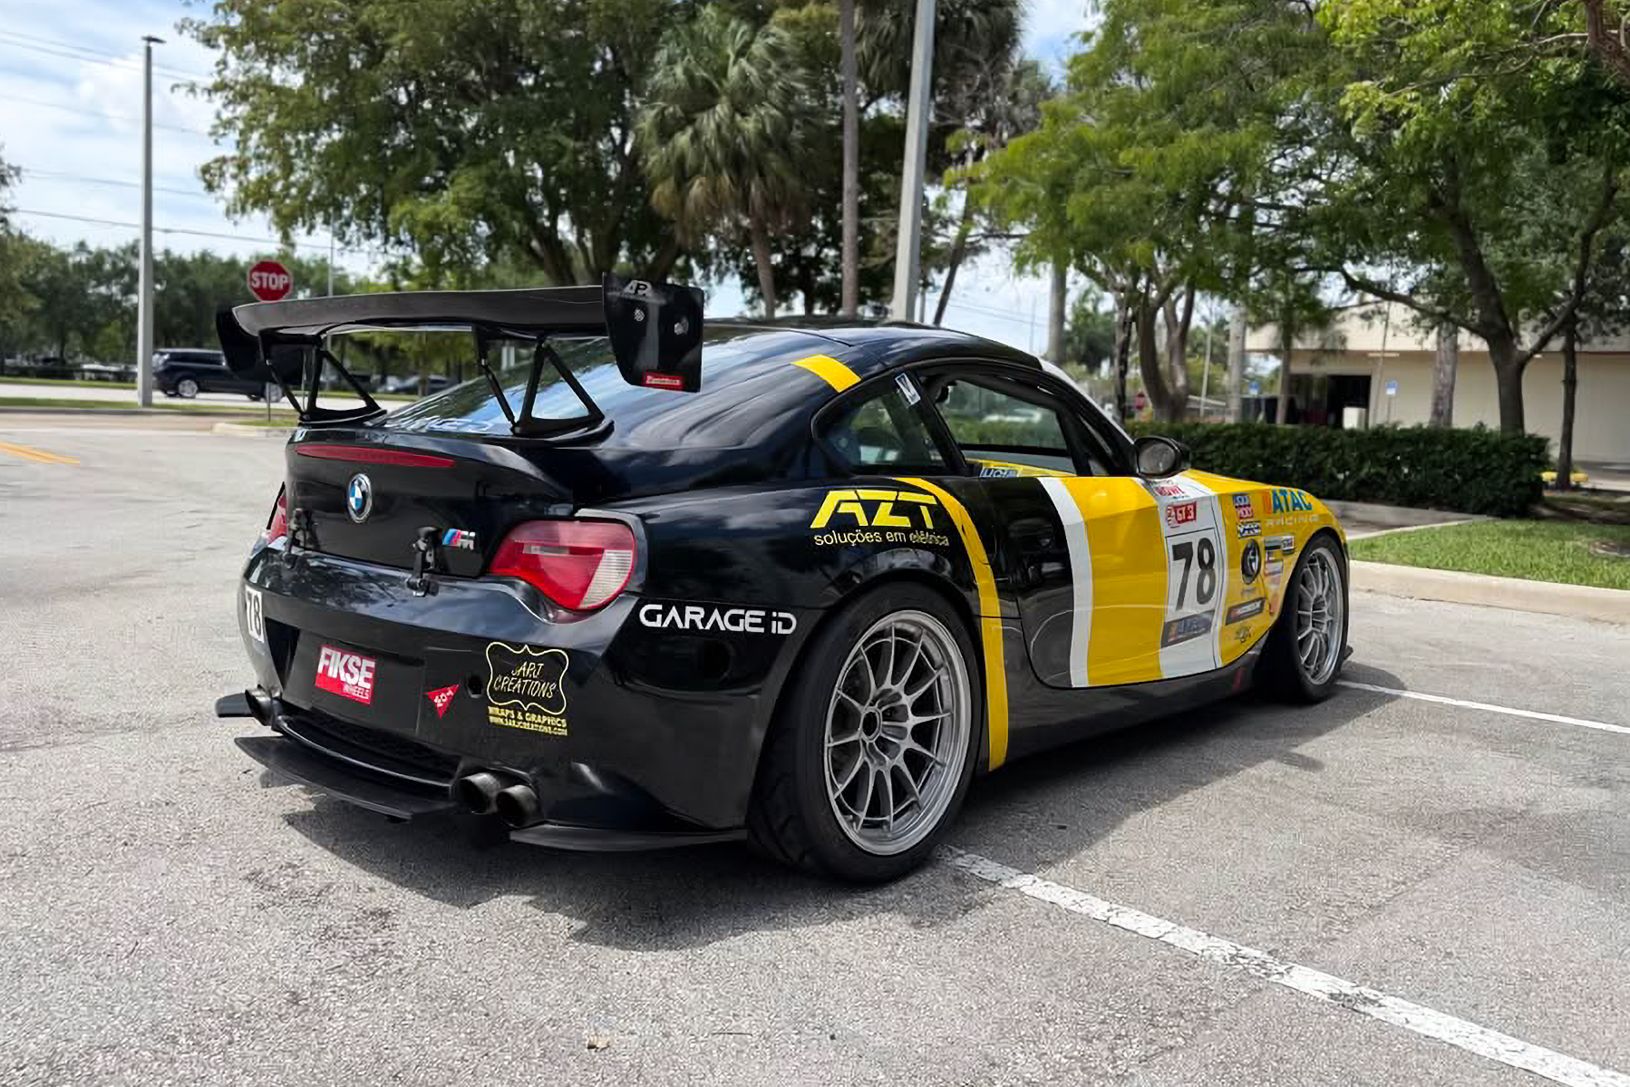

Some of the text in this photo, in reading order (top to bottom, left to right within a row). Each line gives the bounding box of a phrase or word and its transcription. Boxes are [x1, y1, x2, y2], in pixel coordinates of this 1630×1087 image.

[251, 272, 288, 290] STOP
[810, 490, 938, 529] AZT
[886, 532, 906, 543] em
[1171, 537, 1216, 611] 78
[639, 604, 765, 633] GARAGE
[317, 646, 376, 690] FIKSE
[493, 675, 557, 699] CREATIONS
[525, 712, 567, 728] GRAPHICS
